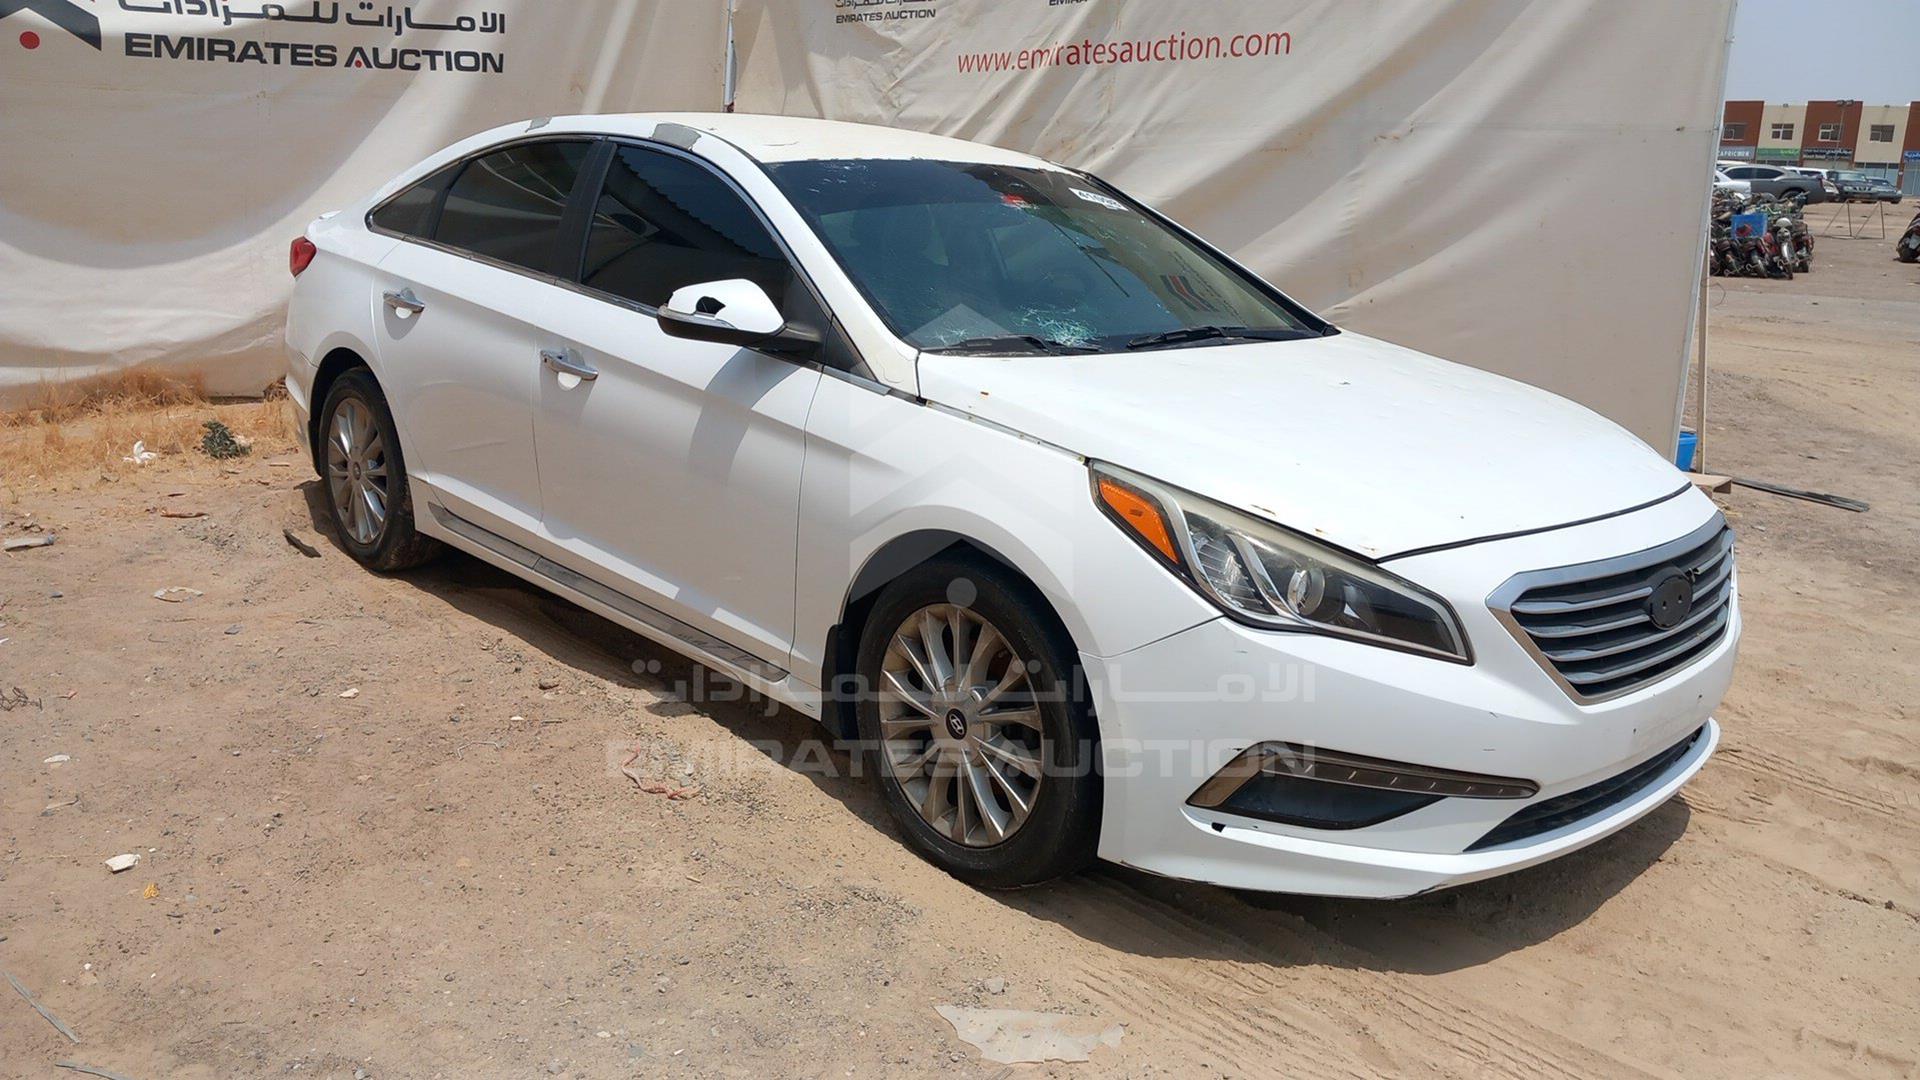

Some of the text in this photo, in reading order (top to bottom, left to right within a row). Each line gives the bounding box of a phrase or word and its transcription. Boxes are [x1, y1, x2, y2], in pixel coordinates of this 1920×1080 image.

[884, 9, 936, 20] AUCTION
[125, 32, 504, 73] EMIRATES AUCTION
[957, 31, 1292, 74] www.emiratesauction.com
